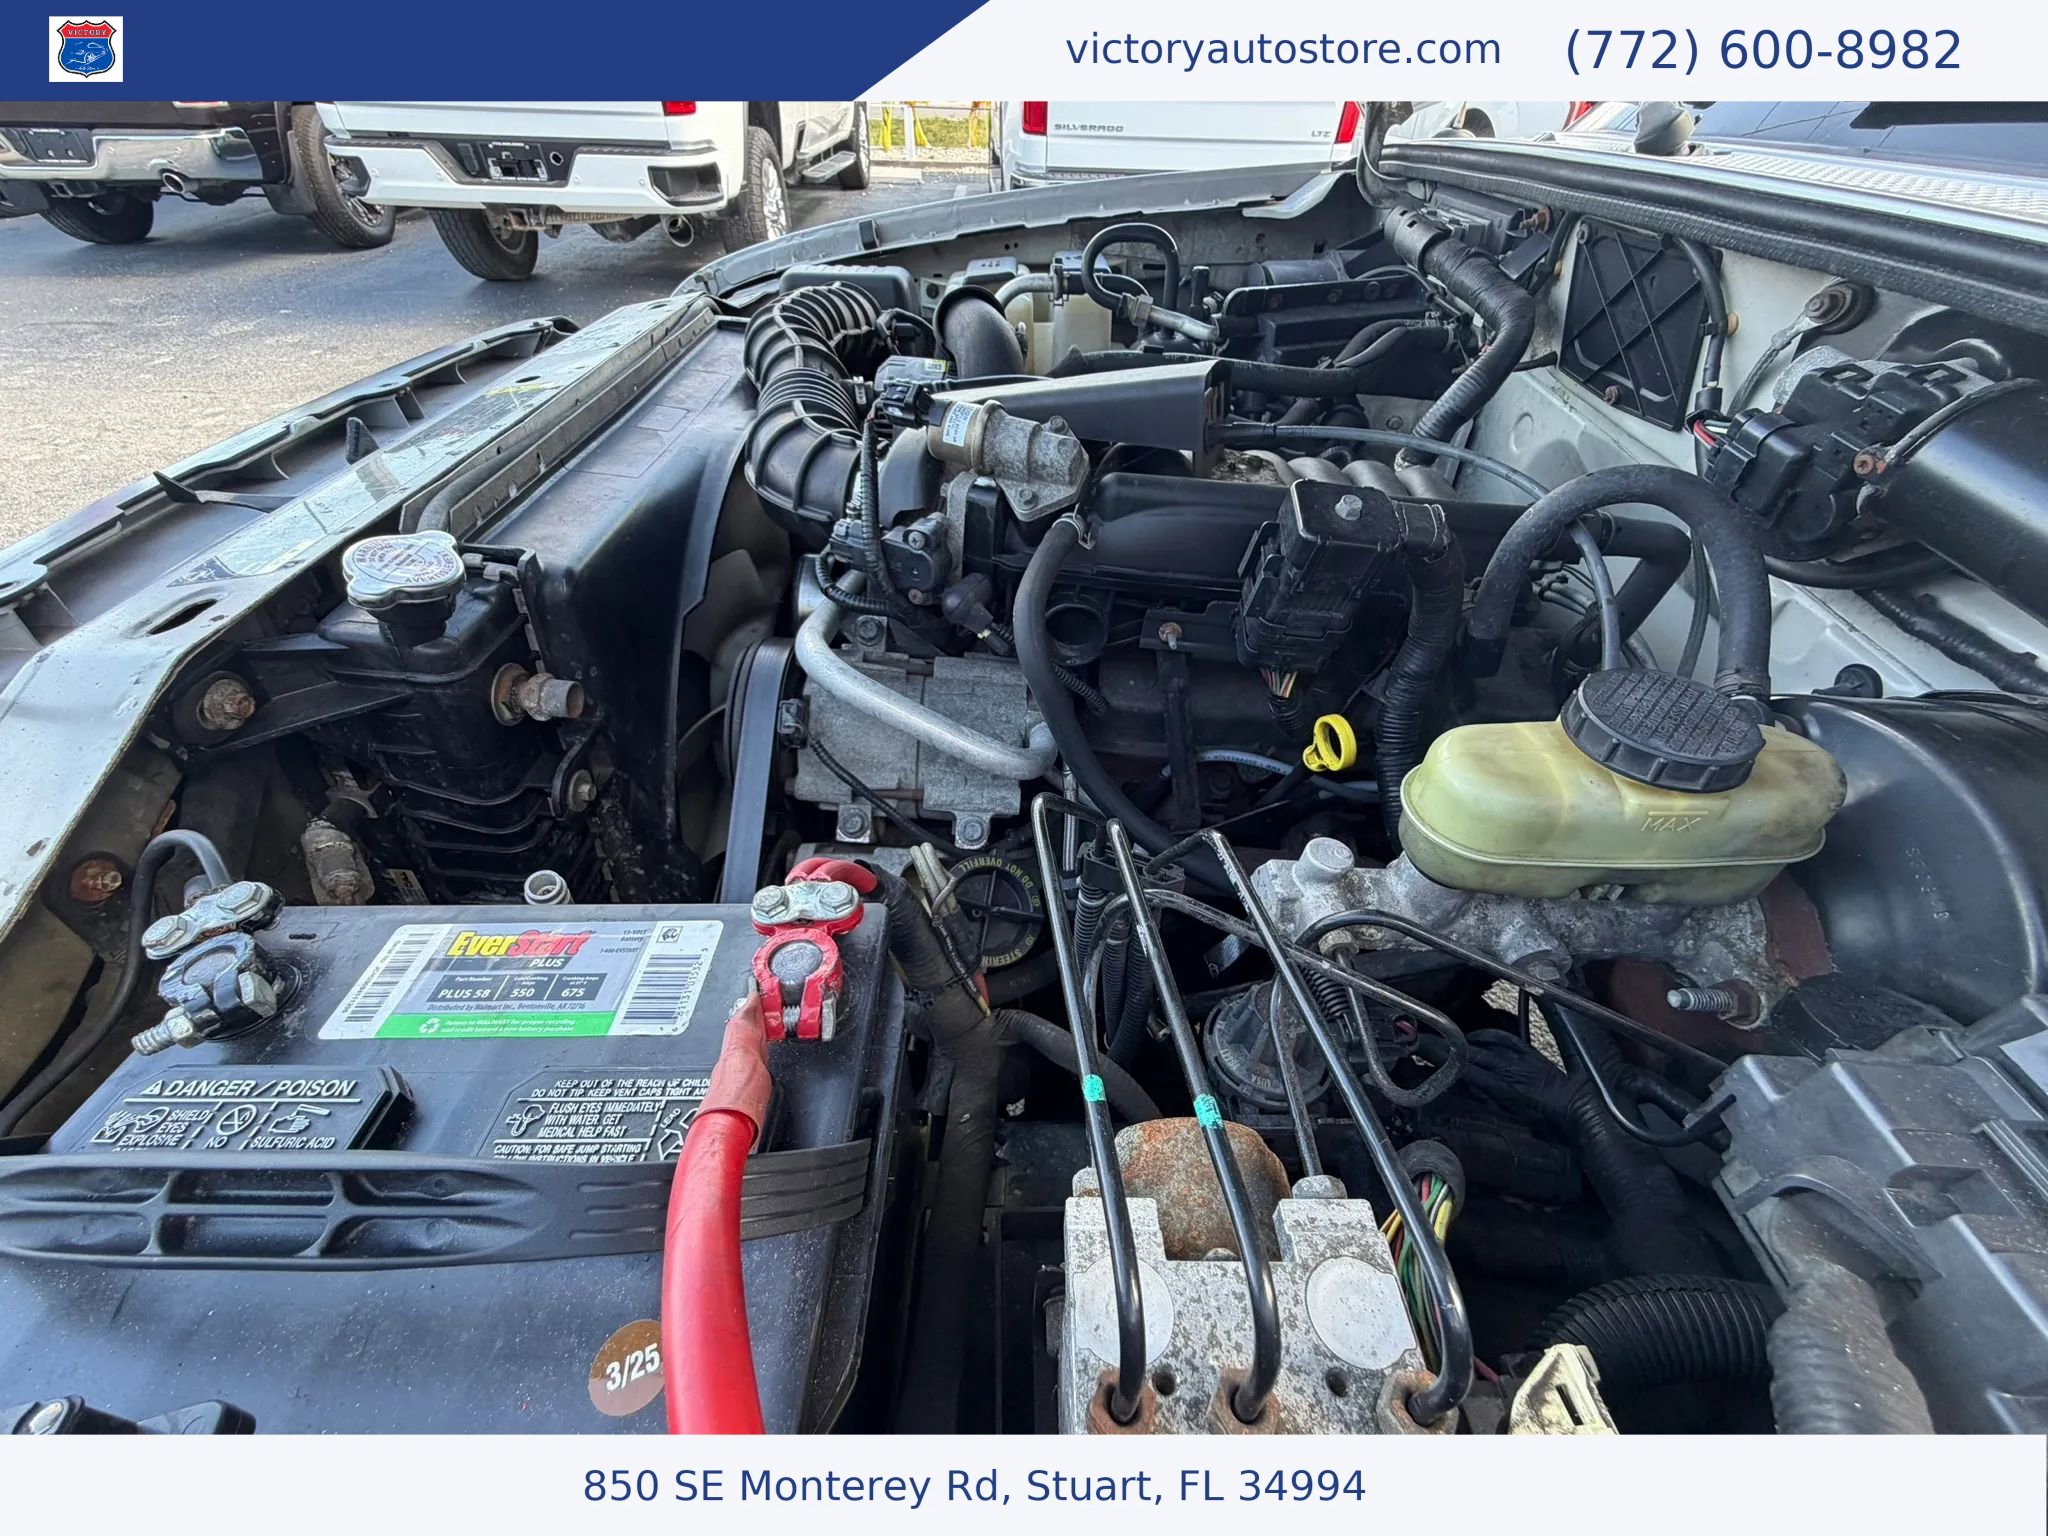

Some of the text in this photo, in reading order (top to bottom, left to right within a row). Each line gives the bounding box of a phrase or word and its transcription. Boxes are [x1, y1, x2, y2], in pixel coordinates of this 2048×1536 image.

[1054, 124, 1124, 132] SILVERADO
[1640, 817, 1701, 831] MAX
[959, 857, 1034, 888] DO NOT OVERFILL
[447, 930, 593, 957] EverStart
[529, 958, 564, 968] PLUS
[982, 949, 1021, 968] STEERIN
[438, 989, 491, 999] PLUS 58
[510, 988, 535, 998] 550
[561, 988, 586, 998] 675
[427, 1003, 467, 1012] Distributed
[475, 1003, 502, 1011] Walmart
[163, 1080, 256, 1096] DANGER
[272, 1080, 357, 1096] POISON
[554, 1079, 578, 1088] KEEP
[580, 1080, 599, 1088] OUT
[600, 1079, 614, 1088] OF
[616, 1079, 634, 1088] THE
[636, 1079, 665, 1088] REACH
[667, 1079, 681, 1087] OF
[531, 1088, 545, 1097] DO
[547, 1088, 567, 1097] NOT
[569, 1088, 585, 1097] TIP.
[587, 1088, 612, 1097] KEEP
[614, 1088, 636, 1096] VENT
[639, 1088, 662, 1096] CAPS
[665, 1088, 690, 1096] TIGHT
[548, 1101, 661, 1113] FLUSH EYES IMMEDIATELY
[169, 1110, 206, 1122] SHIELD
[544, 1115, 567, 1125] WITH
[603, 1114, 622, 1125] GET
[660, 1108, 681, 1128] LEAD
[157, 1122, 188, 1133] EYES
[537, 1126, 627, 1138] MEDICAL HELP FAST
[119, 1134, 184, 1146] EXPLOSIVE
[204, 1137, 227, 1149] NO
[252, 1136, 335, 1149] SULFURIC ACID
[494, 1143, 642, 1154] CAUTION: FOR SAFE JUMP STARTING
[606, 1342, 660, 1391] 3/25
